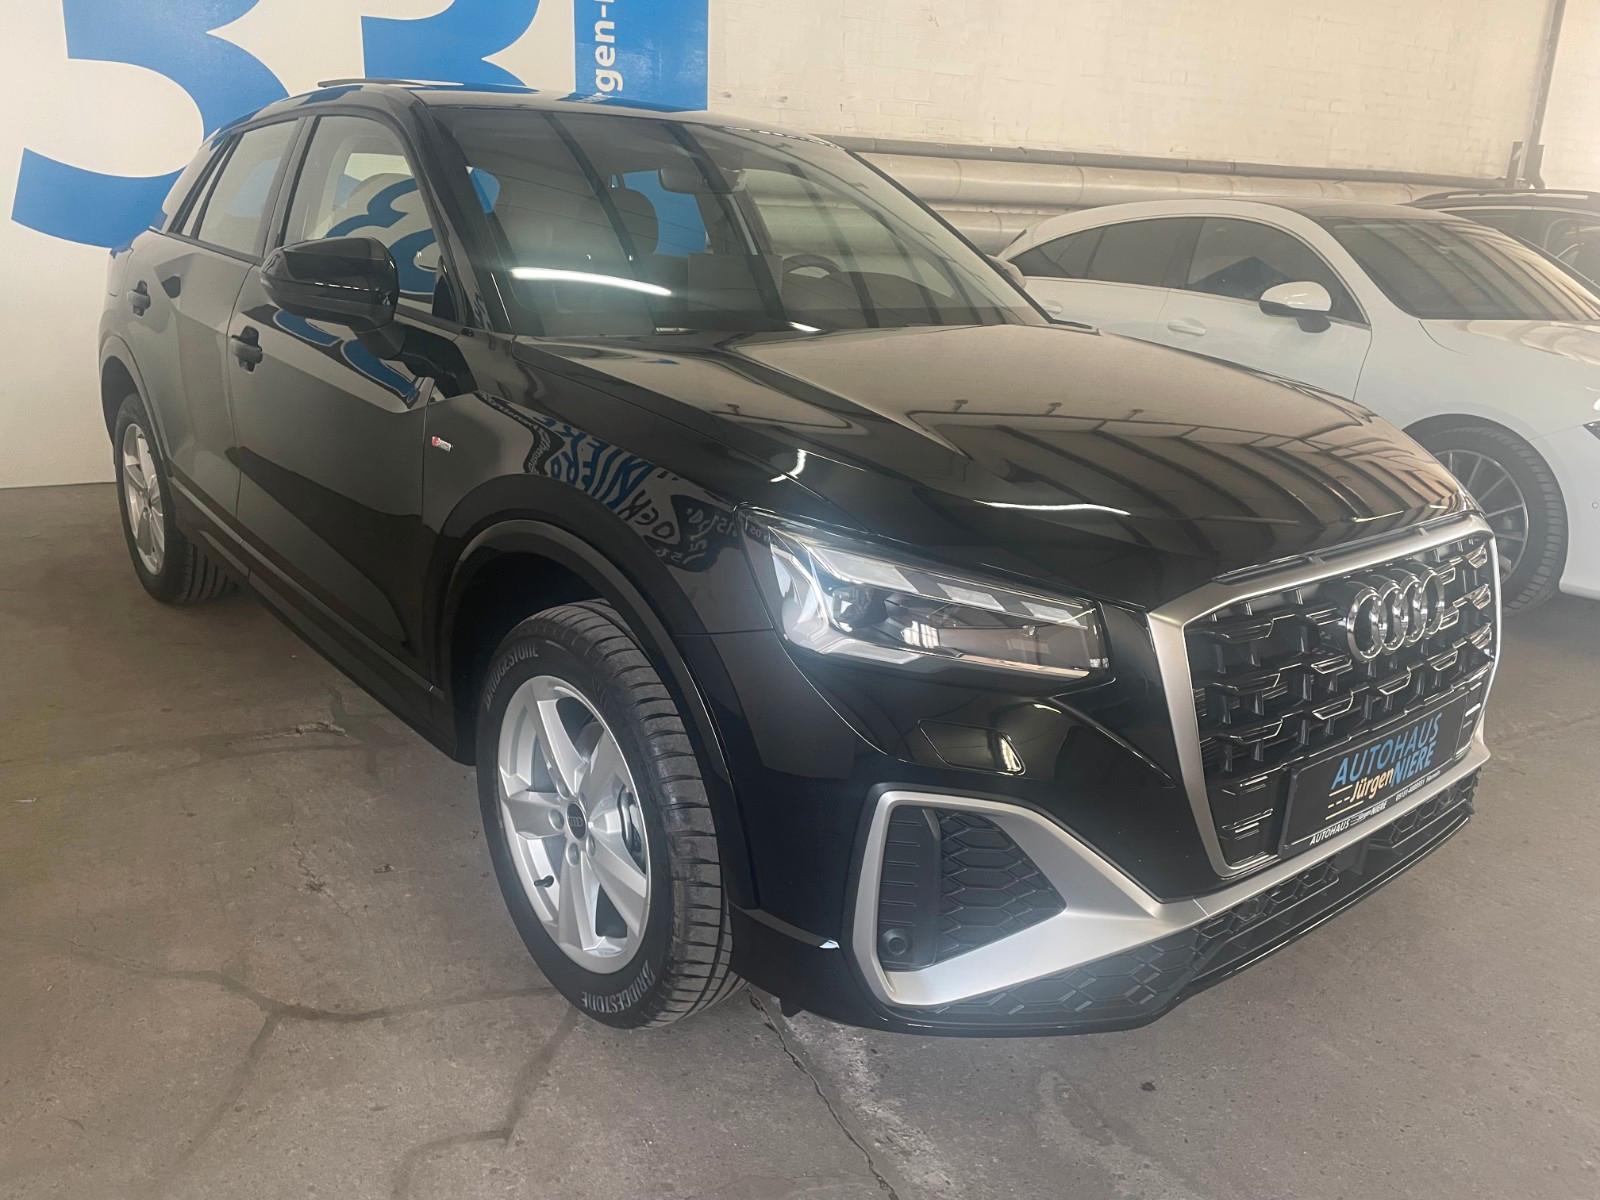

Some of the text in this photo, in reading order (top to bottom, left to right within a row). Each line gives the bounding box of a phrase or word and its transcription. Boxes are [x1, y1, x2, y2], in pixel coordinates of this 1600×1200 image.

[594, 0, 624, 98] gen-
[1330, 712, 1443, 790] AUTOHAUS
[1349, 767, 1394, 803] Jürgen
[1390, 740, 1438, 788] NIERE
[1309, 818, 1351, 847] AUTOHAUS
[582, 959, 657, 1014] BRIDGESTONE
